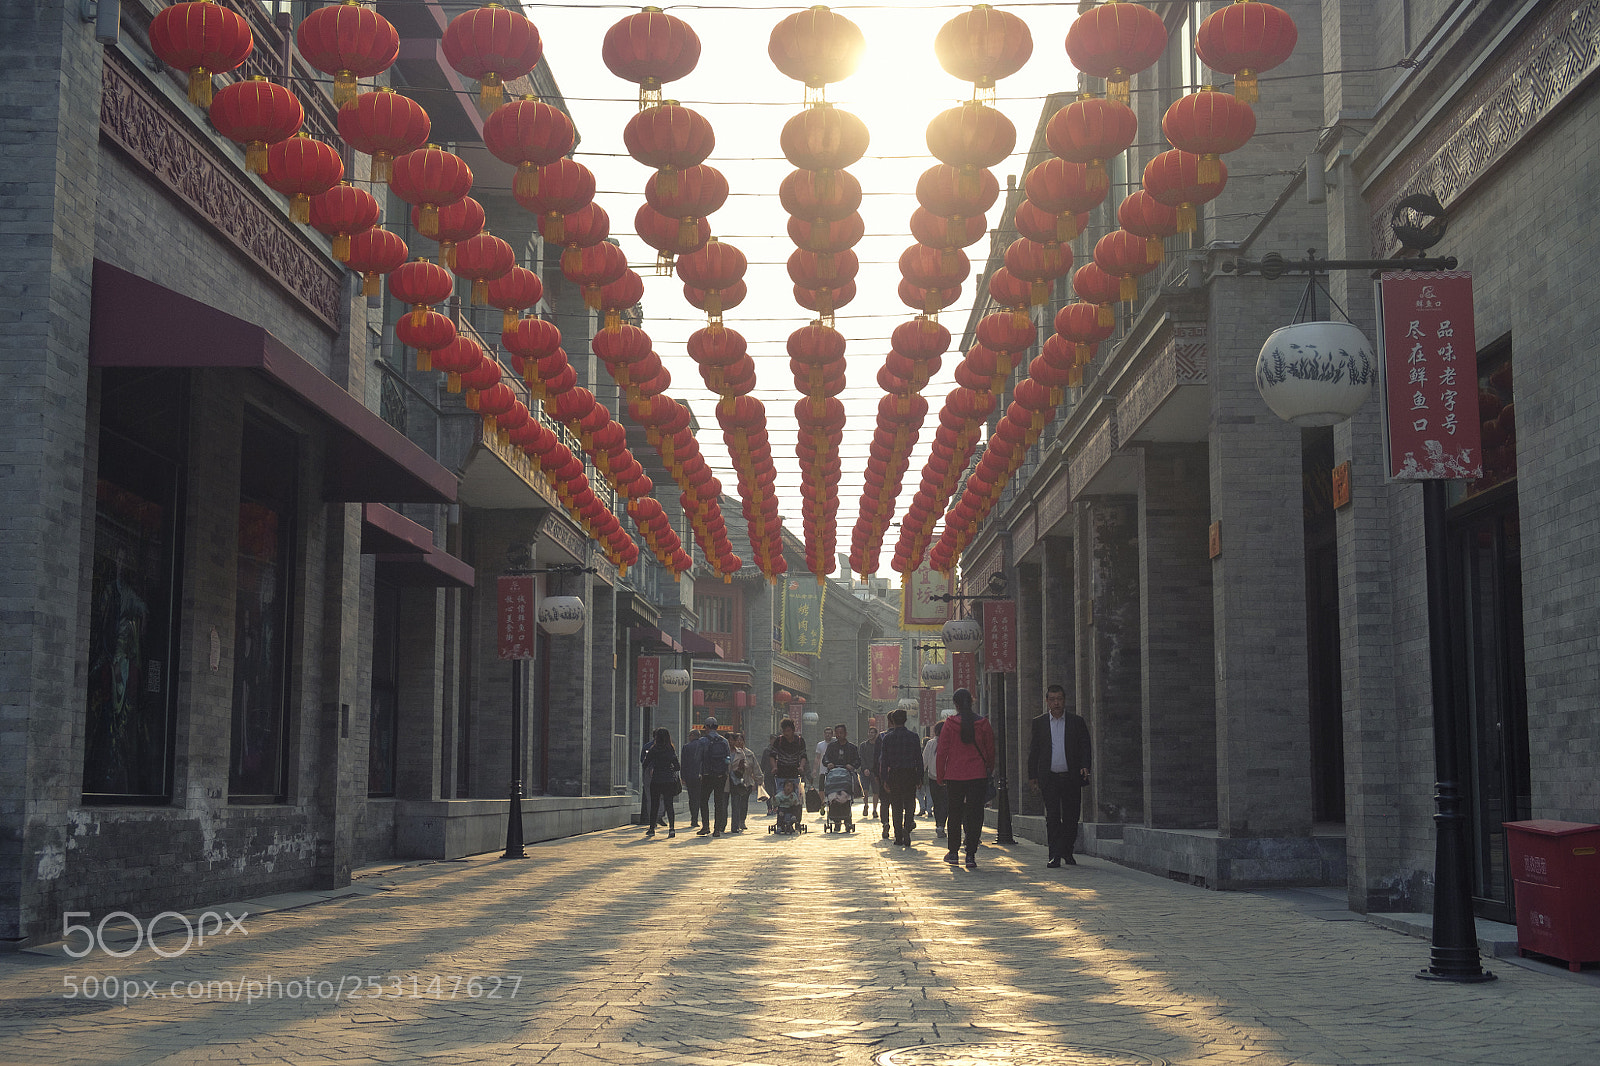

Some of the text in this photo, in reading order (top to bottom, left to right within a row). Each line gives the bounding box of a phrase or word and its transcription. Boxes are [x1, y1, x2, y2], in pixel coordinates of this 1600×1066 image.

[1404, 320, 1430, 433] 尽在鲜鱼口
[1436, 320, 1459, 436] 品味老字号
[798, 602, 809, 647] 烤肉季
